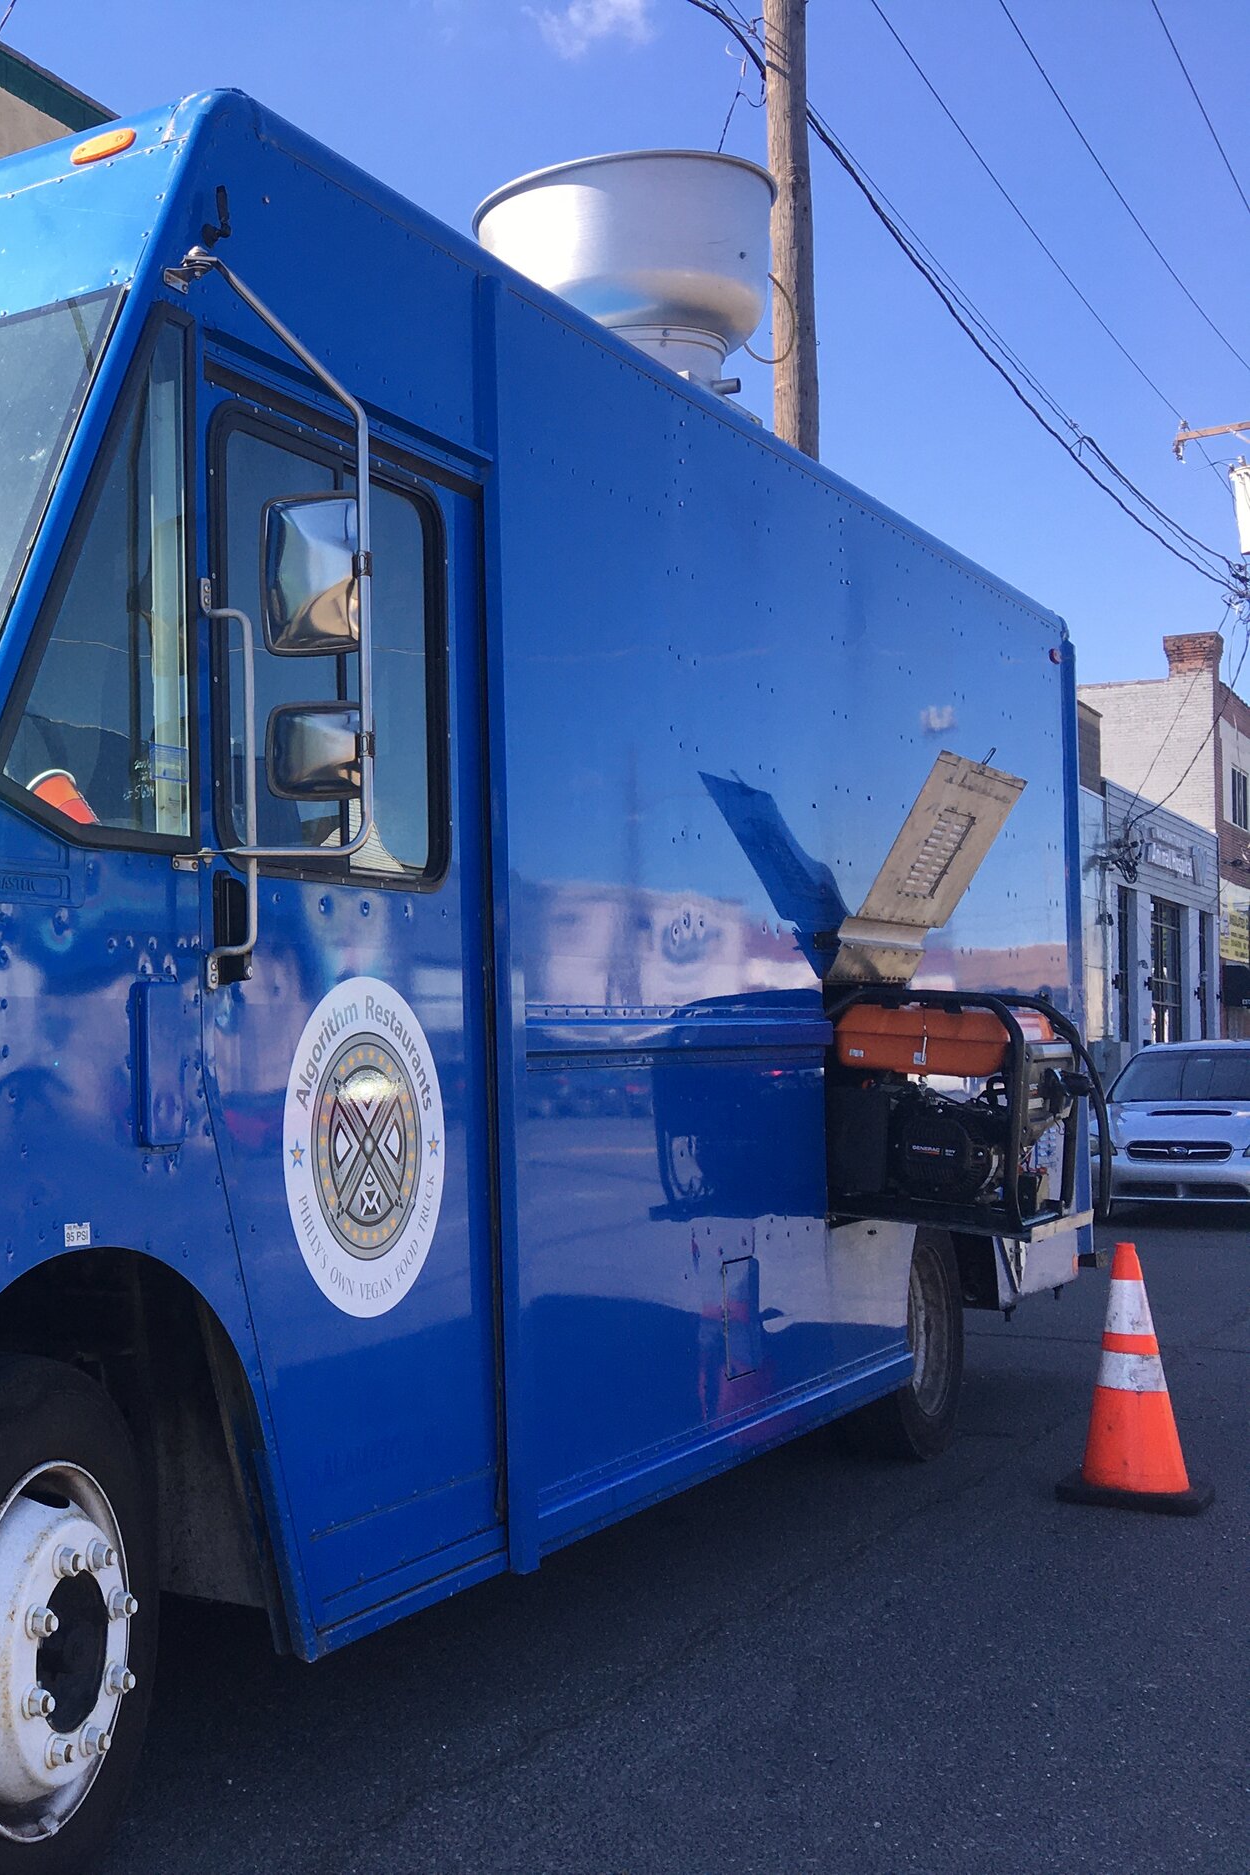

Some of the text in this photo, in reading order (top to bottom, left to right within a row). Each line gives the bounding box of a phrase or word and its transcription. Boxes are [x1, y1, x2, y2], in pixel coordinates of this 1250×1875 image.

[295, 995, 432, 1112] Algorithm Restaurants
[66, 1230, 89, 1242] 95 PSI
[299, 1174, 436, 1301] PHILLY'S OWN VEGAN FOOD TRUCK
